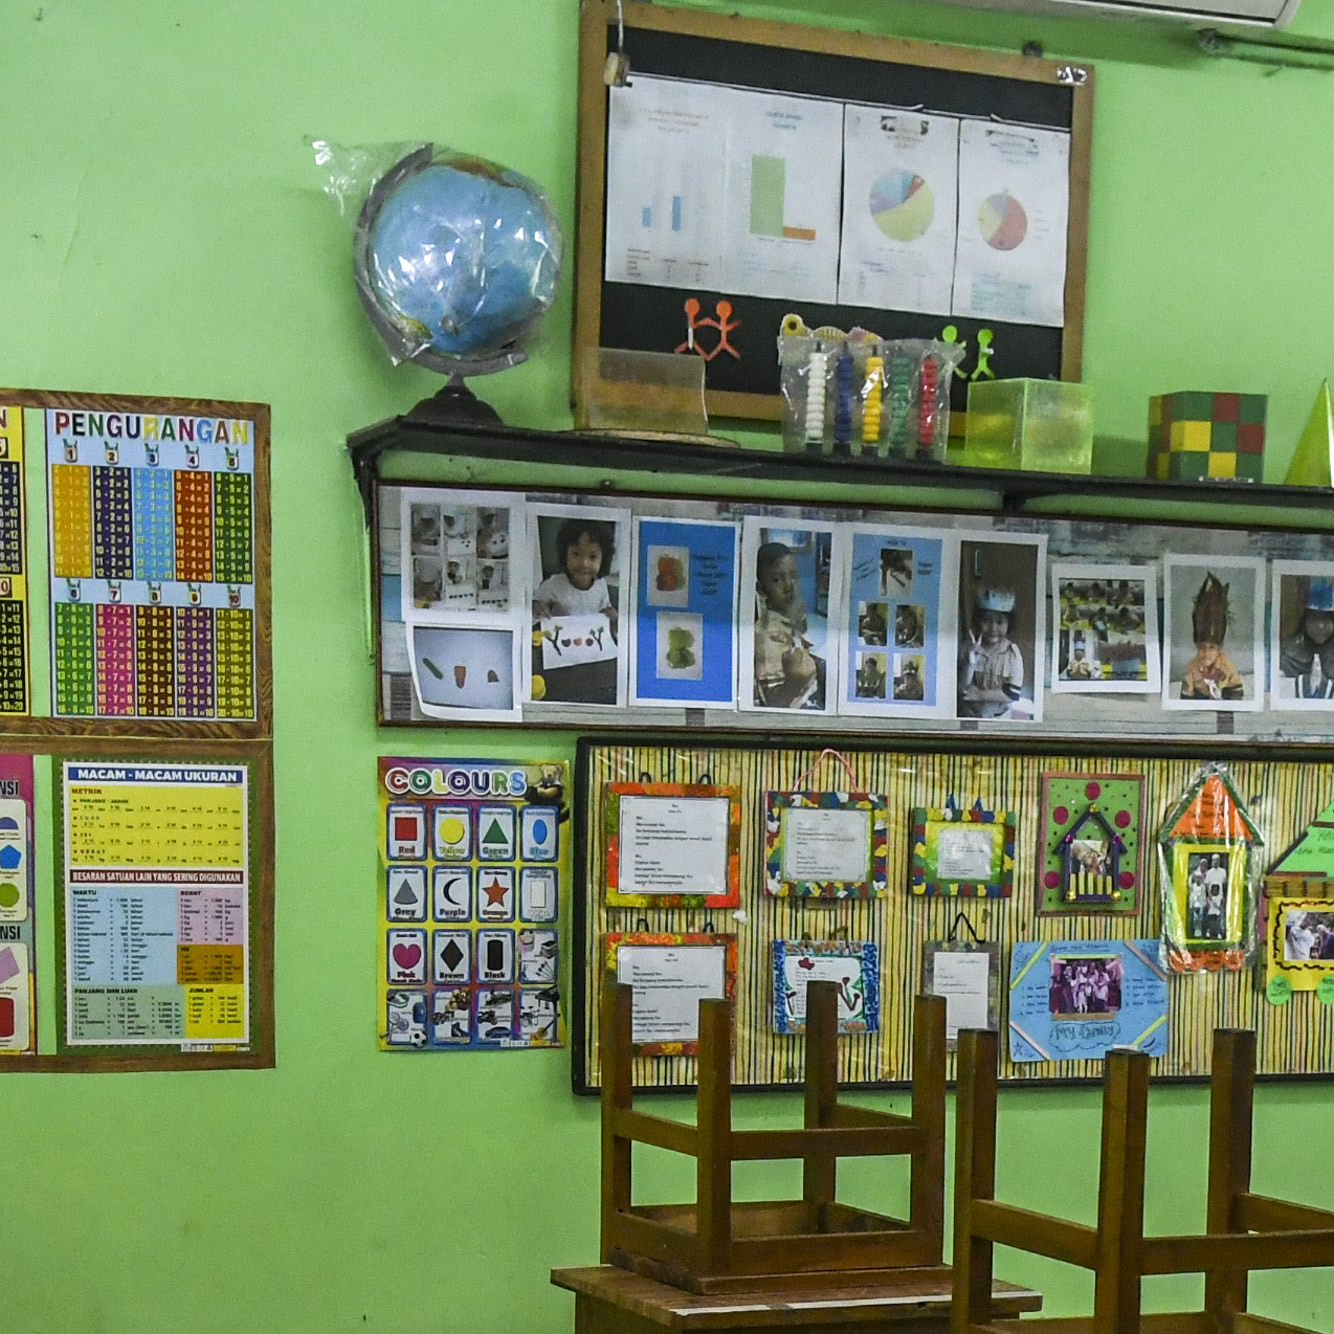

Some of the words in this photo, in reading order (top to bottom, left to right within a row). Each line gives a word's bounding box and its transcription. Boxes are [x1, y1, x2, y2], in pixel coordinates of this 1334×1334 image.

[55, 412, 248, 444] PENGURANGAN
[78, 769, 126, 780] MACAM
[134, 770, 183, 781] MACAM
[184, 771, 237, 782] UKURAN
[385, 767, 528, 796] COLOURS
[398, 846, 416, 854] Red
[482, 847, 509, 855] Green
[72, 871, 106, 882] BESARAN
[107, 872, 134, 882] SATUAN
[135, 872, 152, 882] LAIN
[152, 872, 172, 882] YANG
[172, 873, 198, 882] SERING
[199, 873, 241, 882] DIGUNAKAN
[394, 908, 416, 916] Grey
[439, 908, 466, 916] Purple
[484, 971, 505, 979] Black
